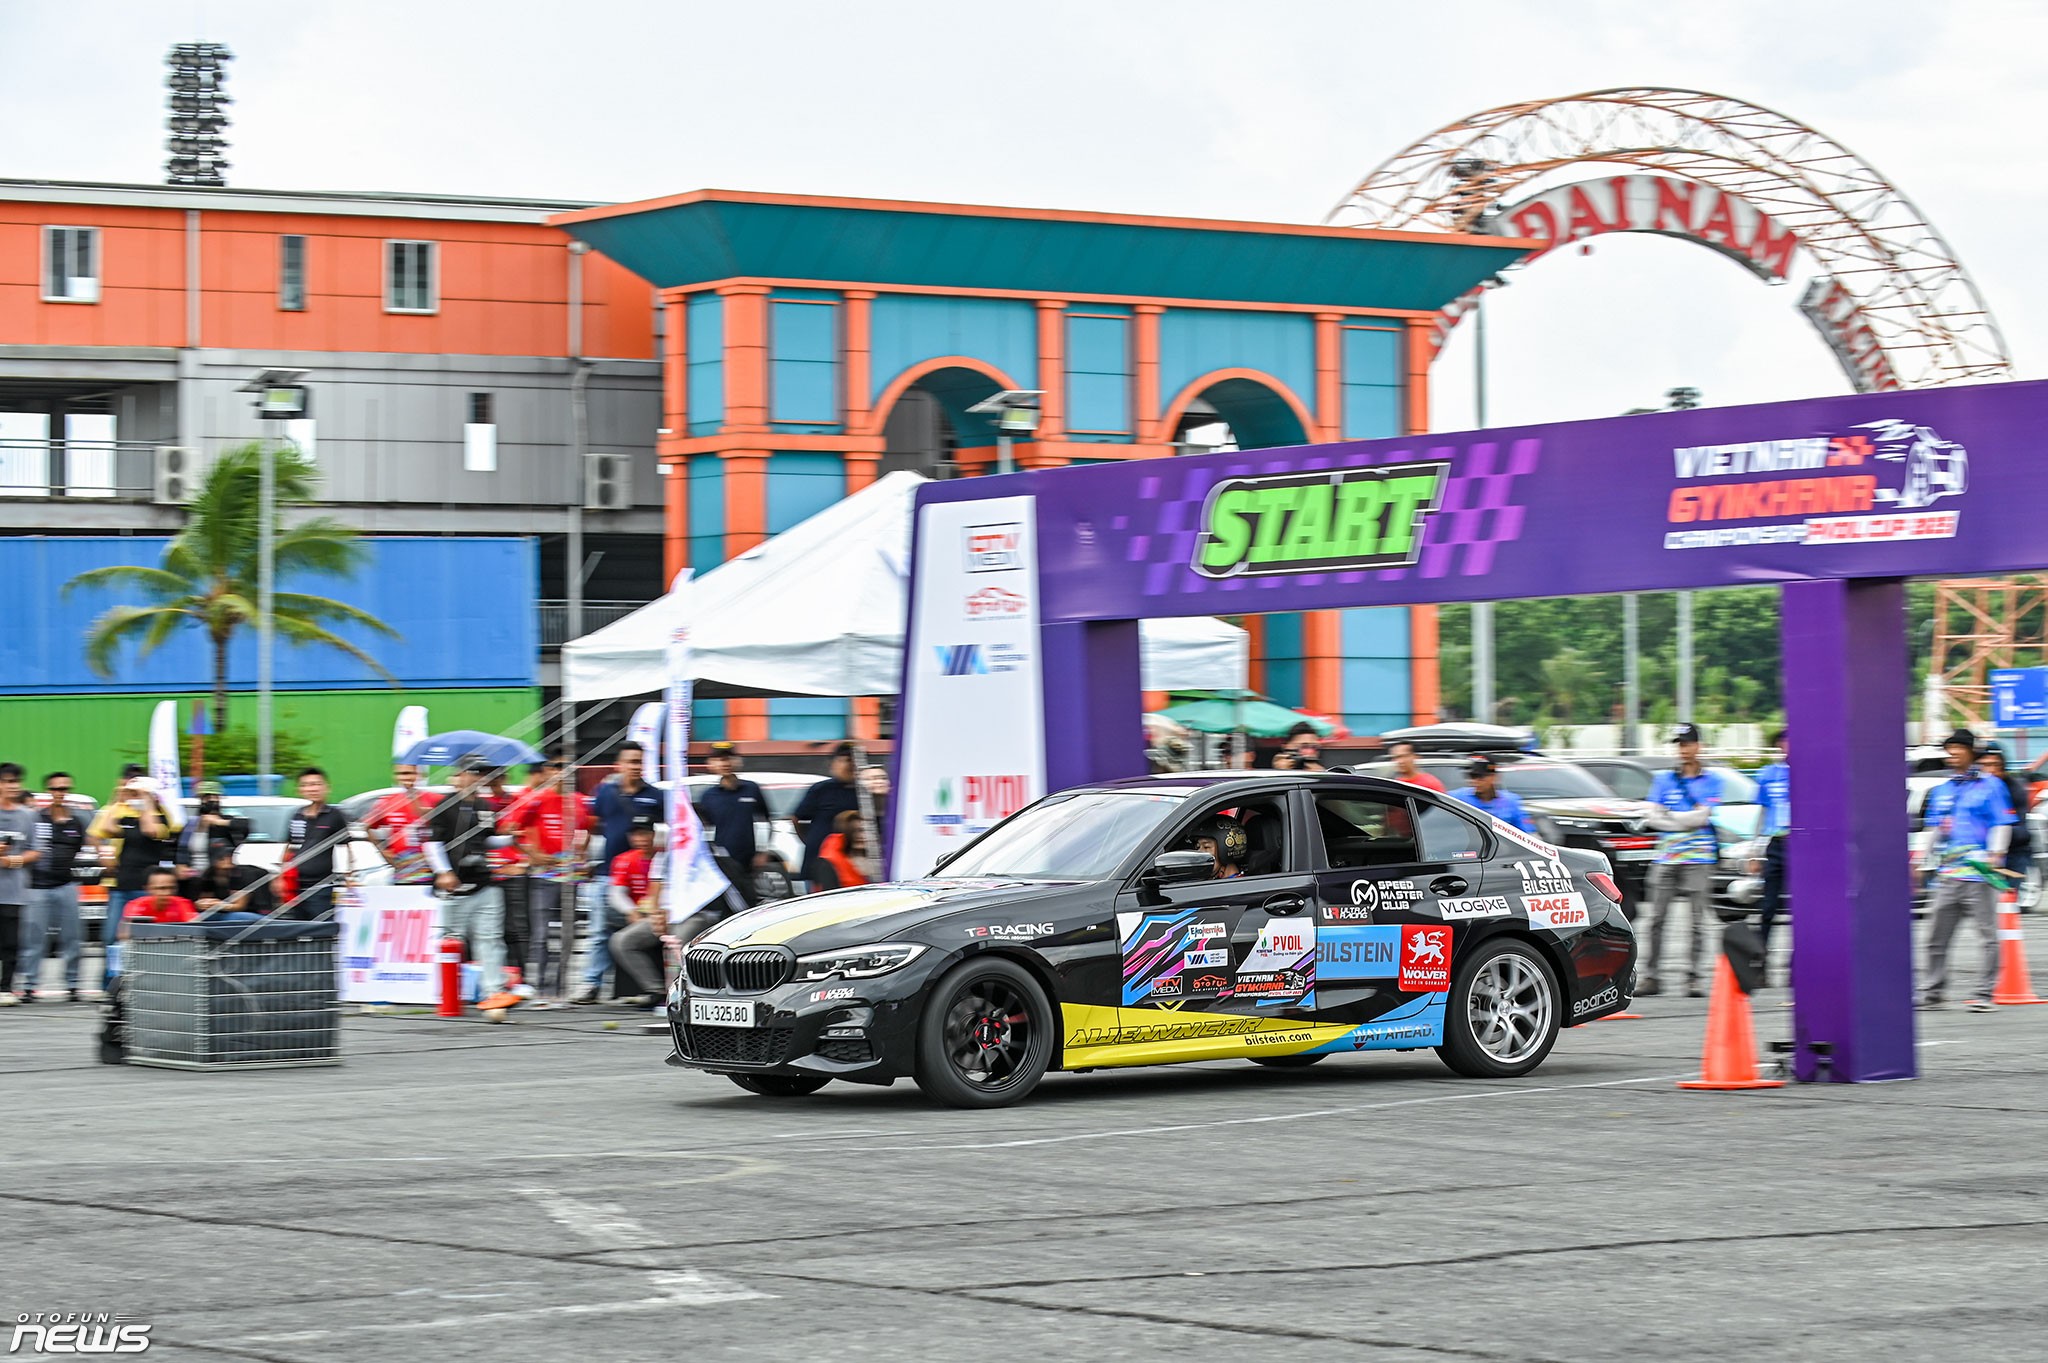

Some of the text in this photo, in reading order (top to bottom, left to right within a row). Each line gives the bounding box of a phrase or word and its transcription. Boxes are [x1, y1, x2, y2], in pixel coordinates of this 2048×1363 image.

[1655, 177, 1797, 278] NAM
[1202, 475, 1439, 567] START
[1378, 880, 1414, 890] SPEED
[1521, 878, 1575, 894] BILSTEIN
[1380, 890, 1424, 900] MASTER
[1381, 901, 1409, 910] CLUB
[1527, 898, 1570, 912] RACE
[1550, 911, 1585, 925] CHIP
[964, 922, 1054, 937] T2 RACING
[1273, 935, 1303, 951] PVOIL
[1315, 942, 1393, 962] BILSTEIN
[1237, 974, 1274, 983] VIETNAM
[1402, 966, 1447, 979] WOLVER
[1235, 982, 1285, 992] GYMKHANA
[1573, 988, 1618, 1015] sparco
[695, 1005, 748, 1022] 51L-325.80
[1244, 1032, 1312, 1046] bilstein.com
[1352, 1023, 1435, 1042] WAY AHEAD.
